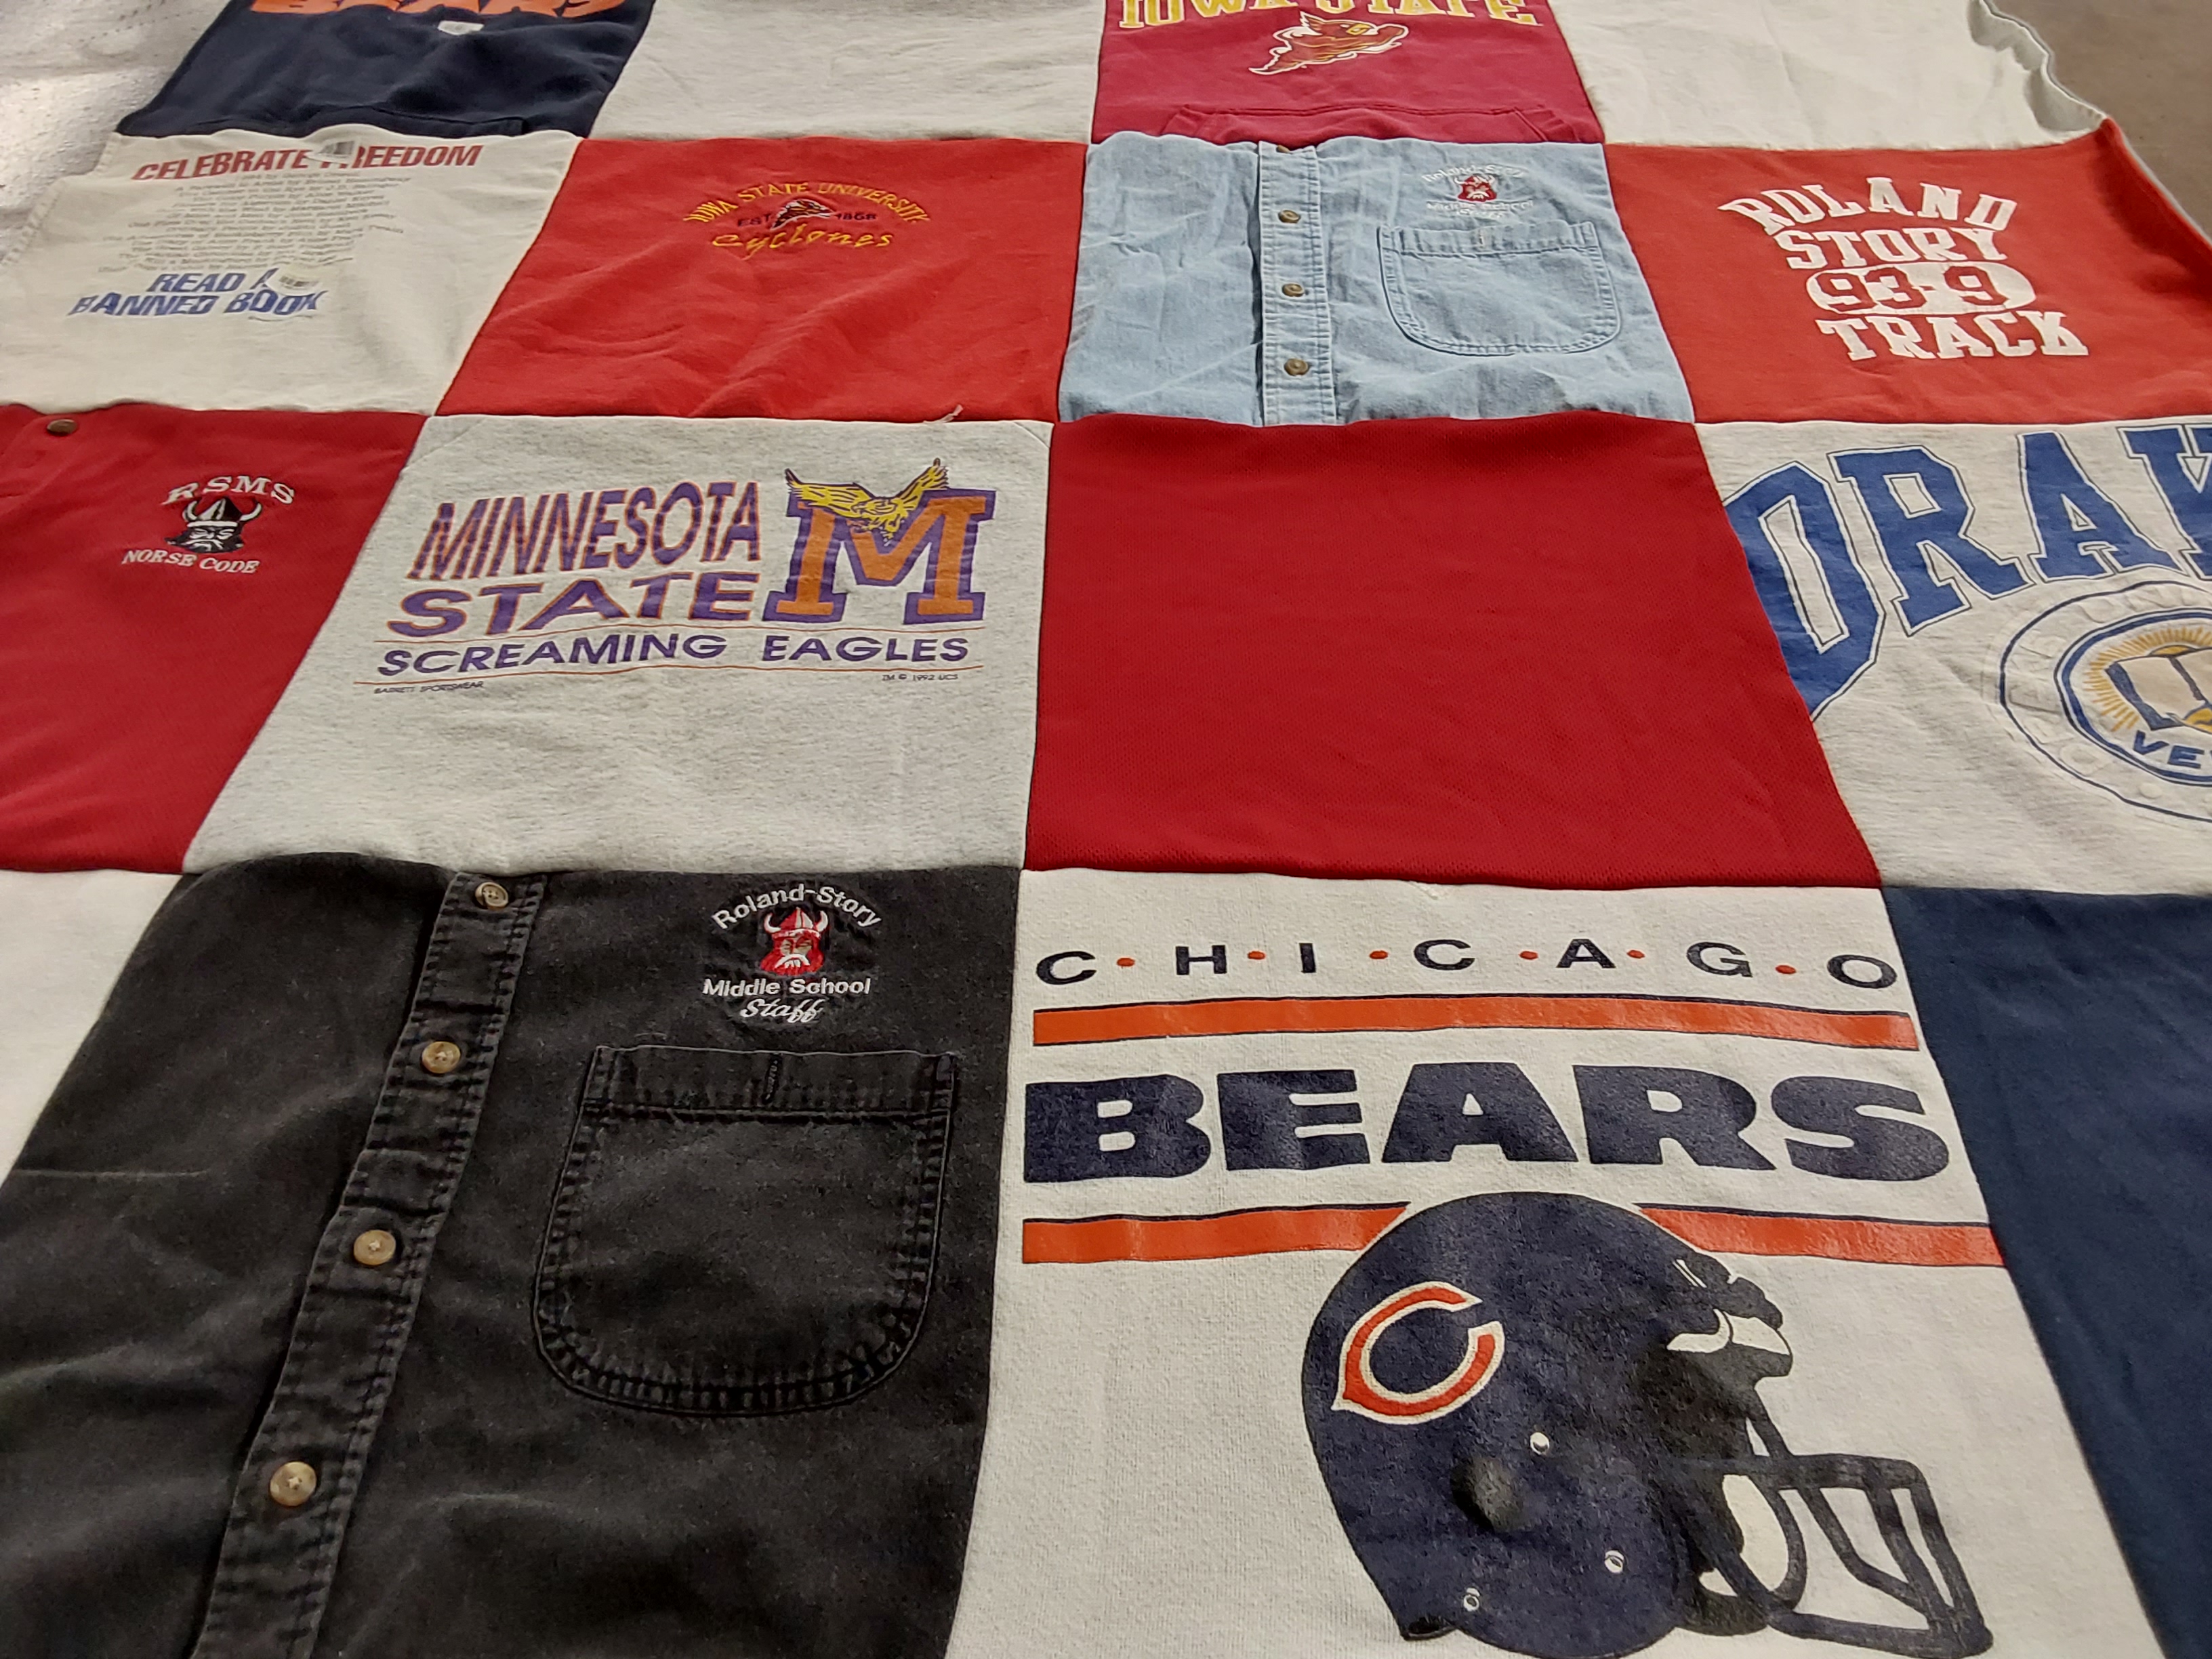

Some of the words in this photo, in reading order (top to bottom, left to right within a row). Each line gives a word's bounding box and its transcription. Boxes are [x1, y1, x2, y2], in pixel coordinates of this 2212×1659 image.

[131, 148, 312, 180] CELEBRATE
[319, 144, 485, 169] REEDOM
[683, 200, 739, 223] IOWA
[737, 182, 809, 203] STATE
[817, 182, 930, 224] UNIVERSITY
[1717, 176, 2018, 236] ROLAND
[712, 223, 893, 261] Cyclones
[1773, 227, 2009, 269] STORY
[66, 292, 220, 316] BANNED
[223, 289, 329, 316] BOOK
[146, 272, 247, 293] READ
[1814, 310, 2089, 361] TRACK
[161, 475, 295, 506] RSMS
[407, 480, 760, 581] MINNESOTA
[121, 549, 197, 567] NORSE
[199, 557, 260, 574] CODE
[762, 488, 997, 624] M
[387, 571, 760, 638] STATE
[377, 633, 728, 677] SCREAMING
[762, 635, 968, 663] EAGLES
[419, 680, 484, 692] SPORTSWEAR
[2133, 730, 2212, 769] VE
[712, 883, 882, 929] Roland-Story
[702, 978, 780, 997] Middle
[789, 977, 872, 995] School
[739, 998, 826, 1023] Staff
[1024, 1061, 1950, 1182] BEARS
